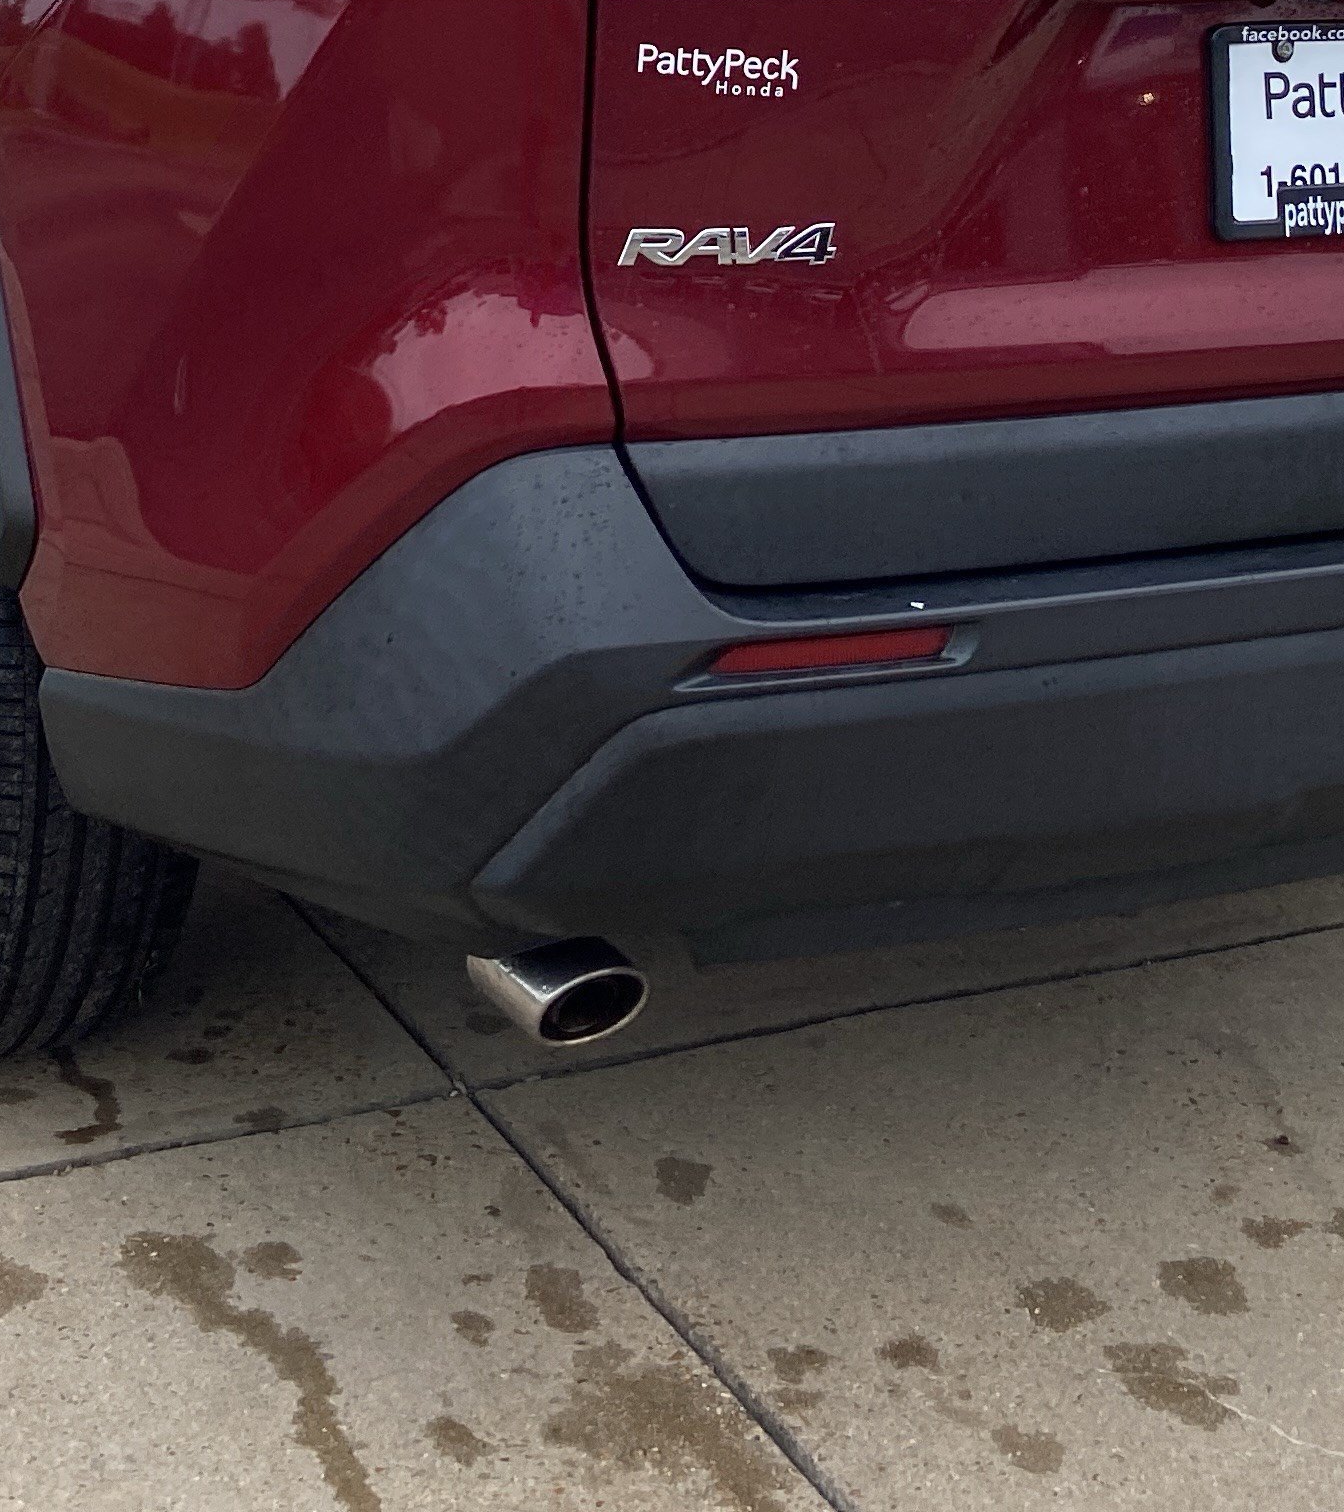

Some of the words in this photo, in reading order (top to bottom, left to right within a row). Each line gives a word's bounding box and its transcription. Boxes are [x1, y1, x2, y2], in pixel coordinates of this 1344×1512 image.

[637, 43, 799, 90] PattyPeck
[715, 81, 784, 98] Honda
[617, 223, 837, 266] RAV4
